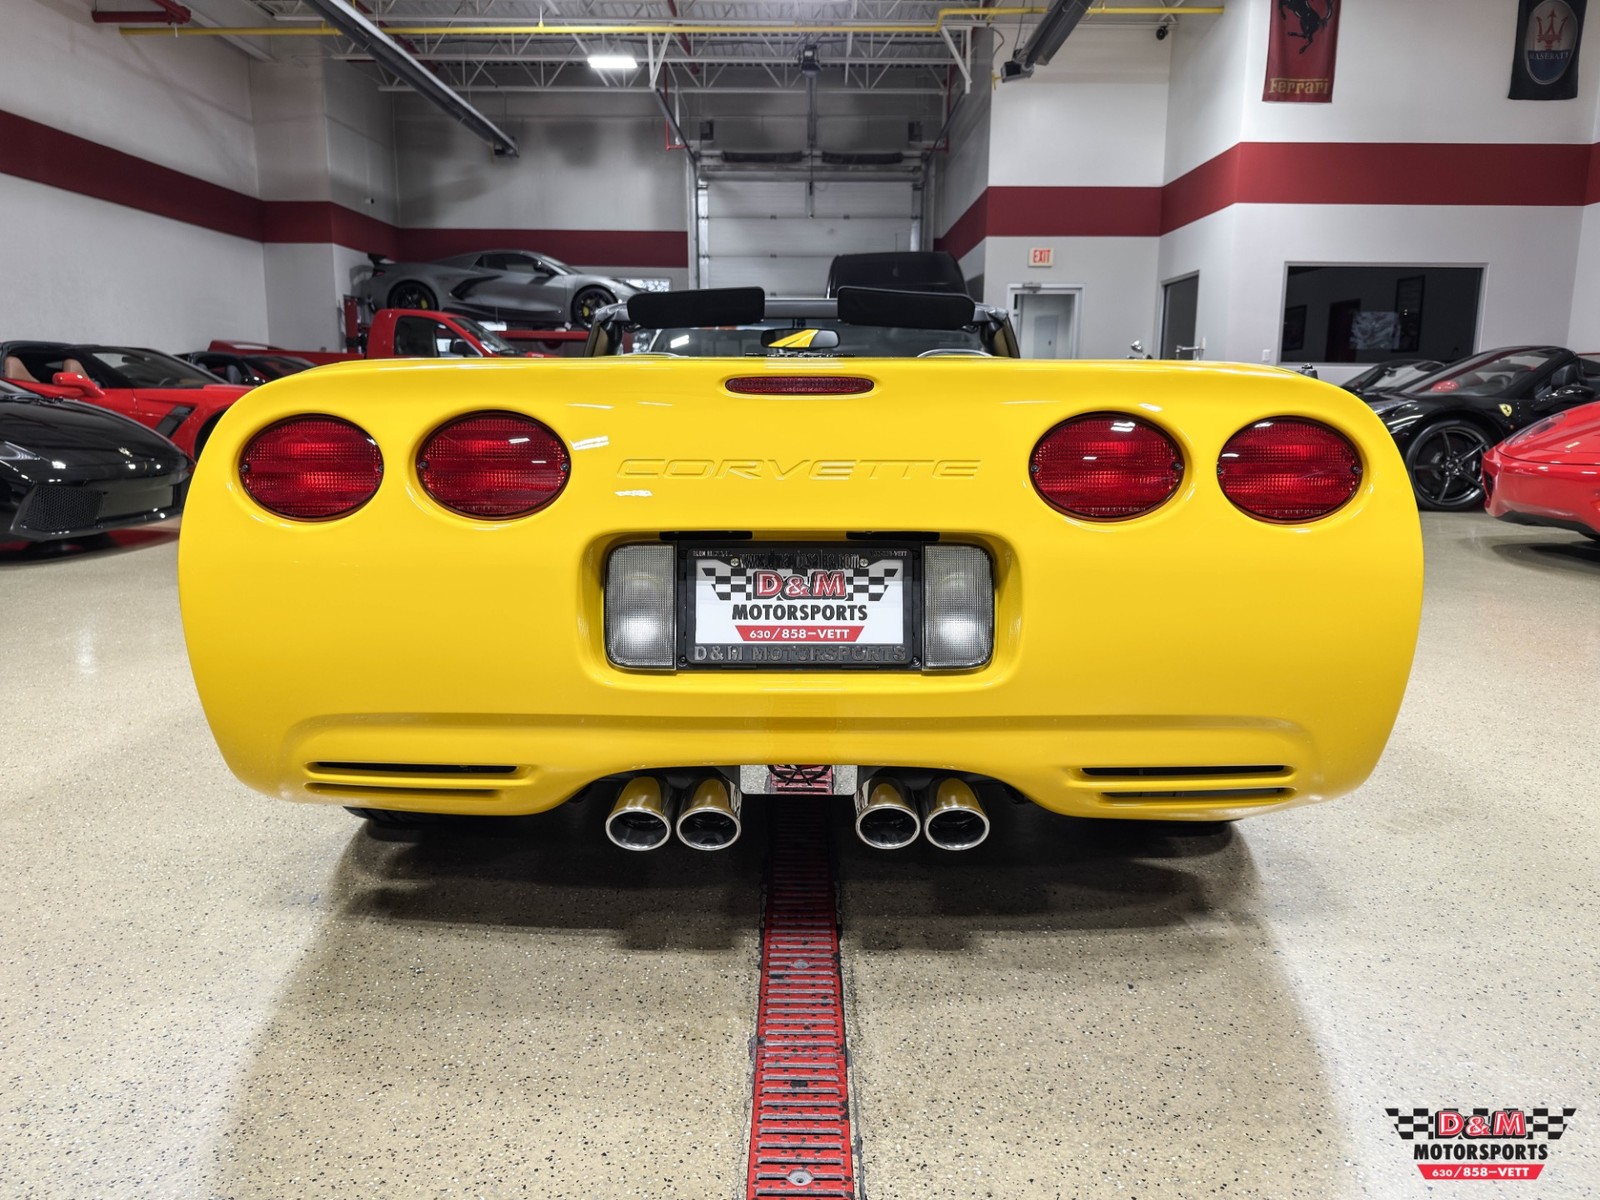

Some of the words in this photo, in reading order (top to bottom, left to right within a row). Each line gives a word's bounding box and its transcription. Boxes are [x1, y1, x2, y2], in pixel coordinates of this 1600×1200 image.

[1529, 51, 1569, 60] MASERATI
[1268, 78, 1328, 95] Ferrari
[1033, 249, 1051, 263] EXIT
[616, 458, 981, 481] CORVETTE
[754, 571, 847, 600] D&M
[732, 604, 868, 621] MOTORSPORTS
[749, 627, 850, 640] 630/858-VETT
[694, 646, 743, 661] D&M
[752, 646, 906, 662] MOTORSPORTS
